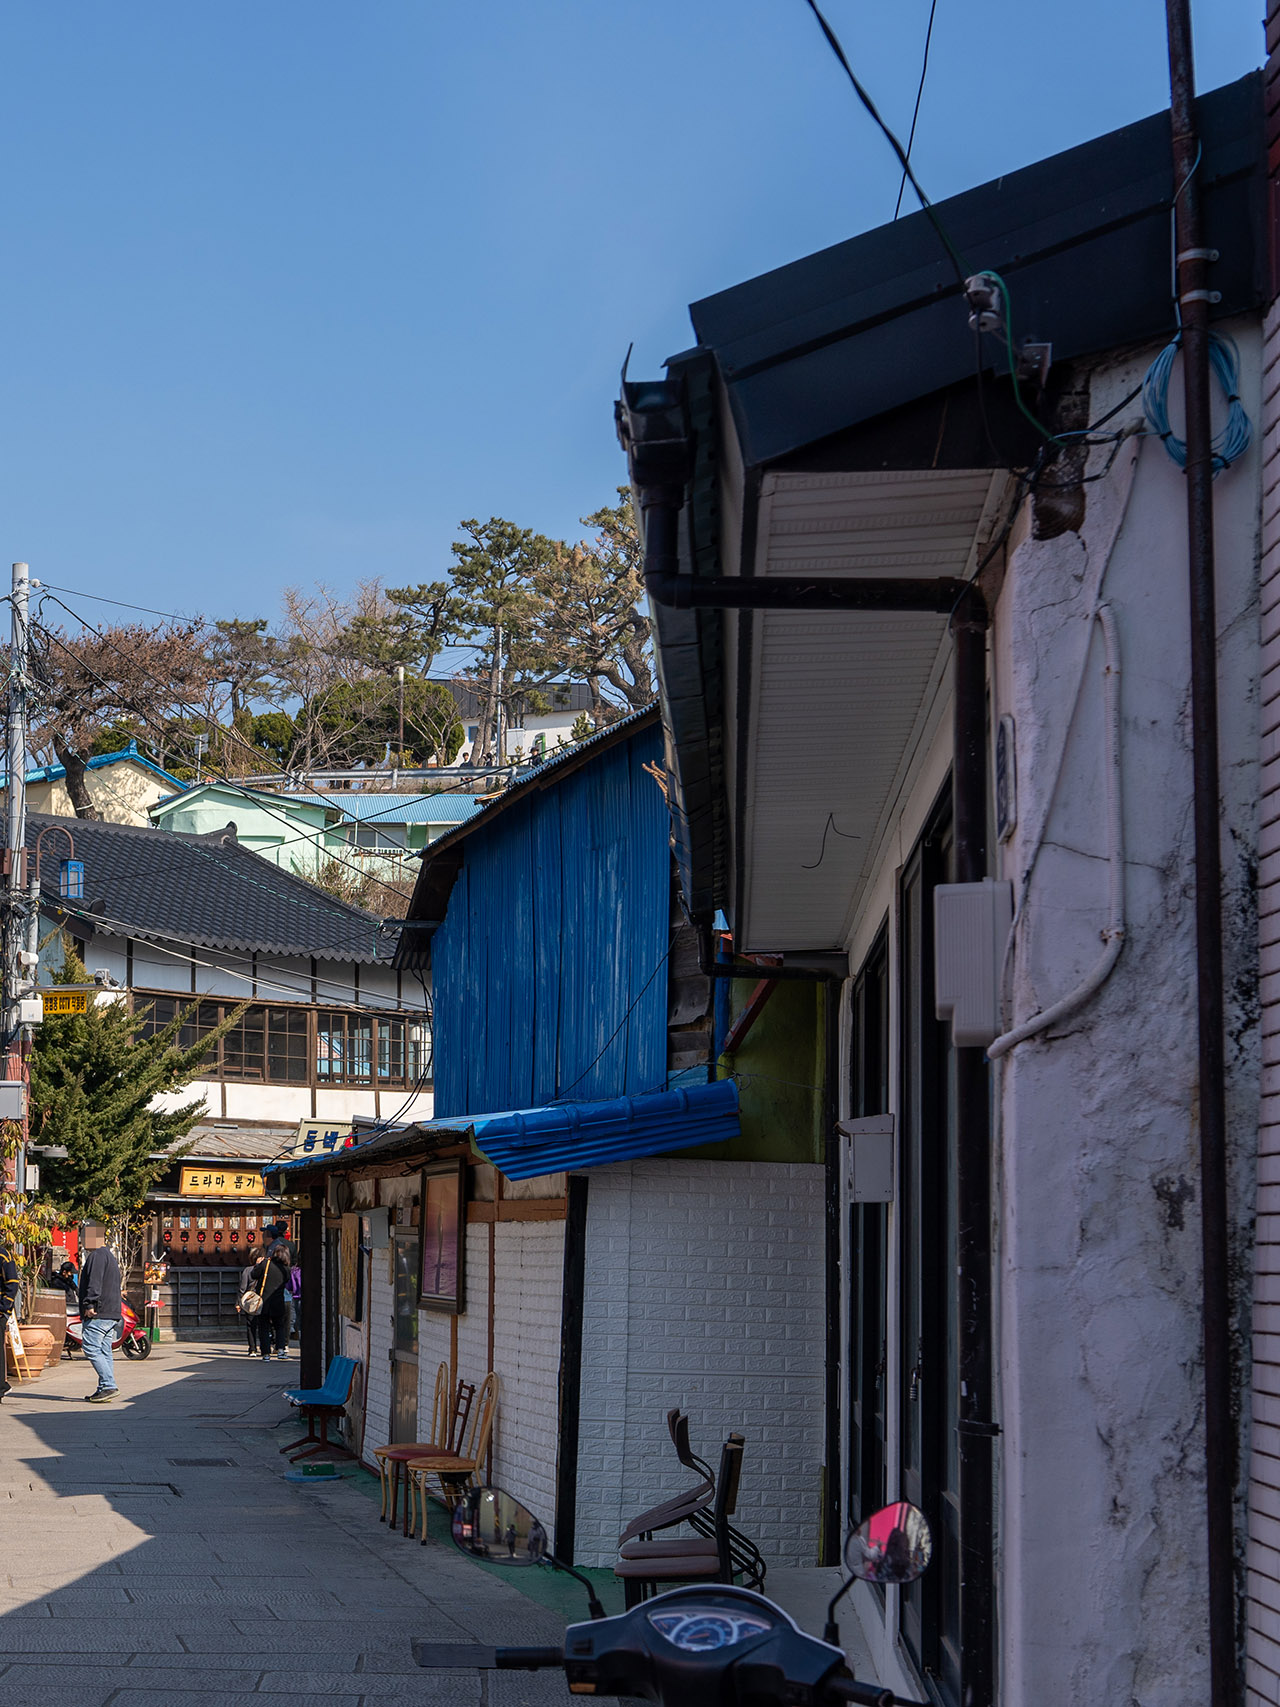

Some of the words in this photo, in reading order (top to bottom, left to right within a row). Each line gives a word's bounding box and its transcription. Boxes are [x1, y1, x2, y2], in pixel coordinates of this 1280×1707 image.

[303, 1129, 339, 1152] 동백
[189, 1174, 225, 1188] 드라마
[233, 1175, 256, 1190] 뽑기
